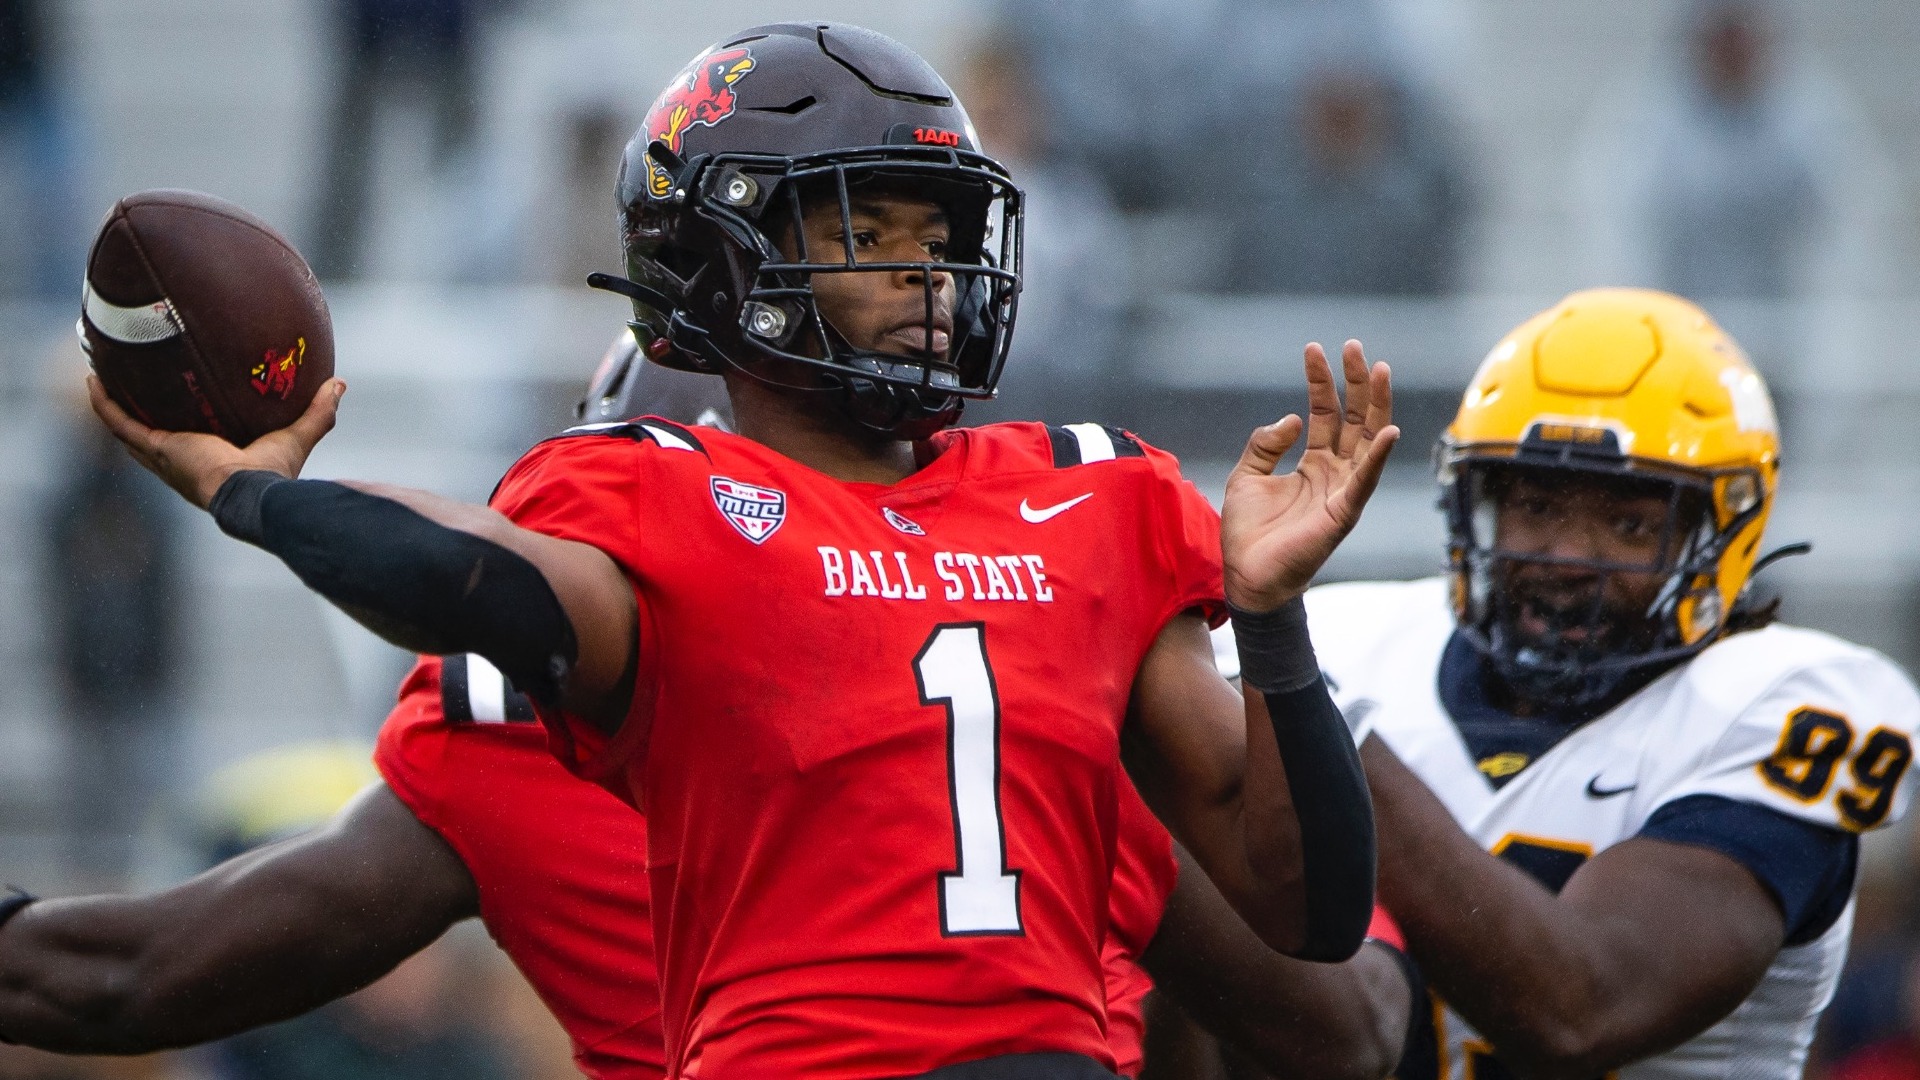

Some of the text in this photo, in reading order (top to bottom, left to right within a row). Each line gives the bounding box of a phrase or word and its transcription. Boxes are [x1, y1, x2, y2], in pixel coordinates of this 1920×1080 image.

[913, 128, 960, 147] 1AAT
[719, 494, 783, 519] MAC
[817, 546, 1053, 602] BALL STATE
[911, 621, 1025, 938] 1
[1755, 705, 1912, 832] 89
